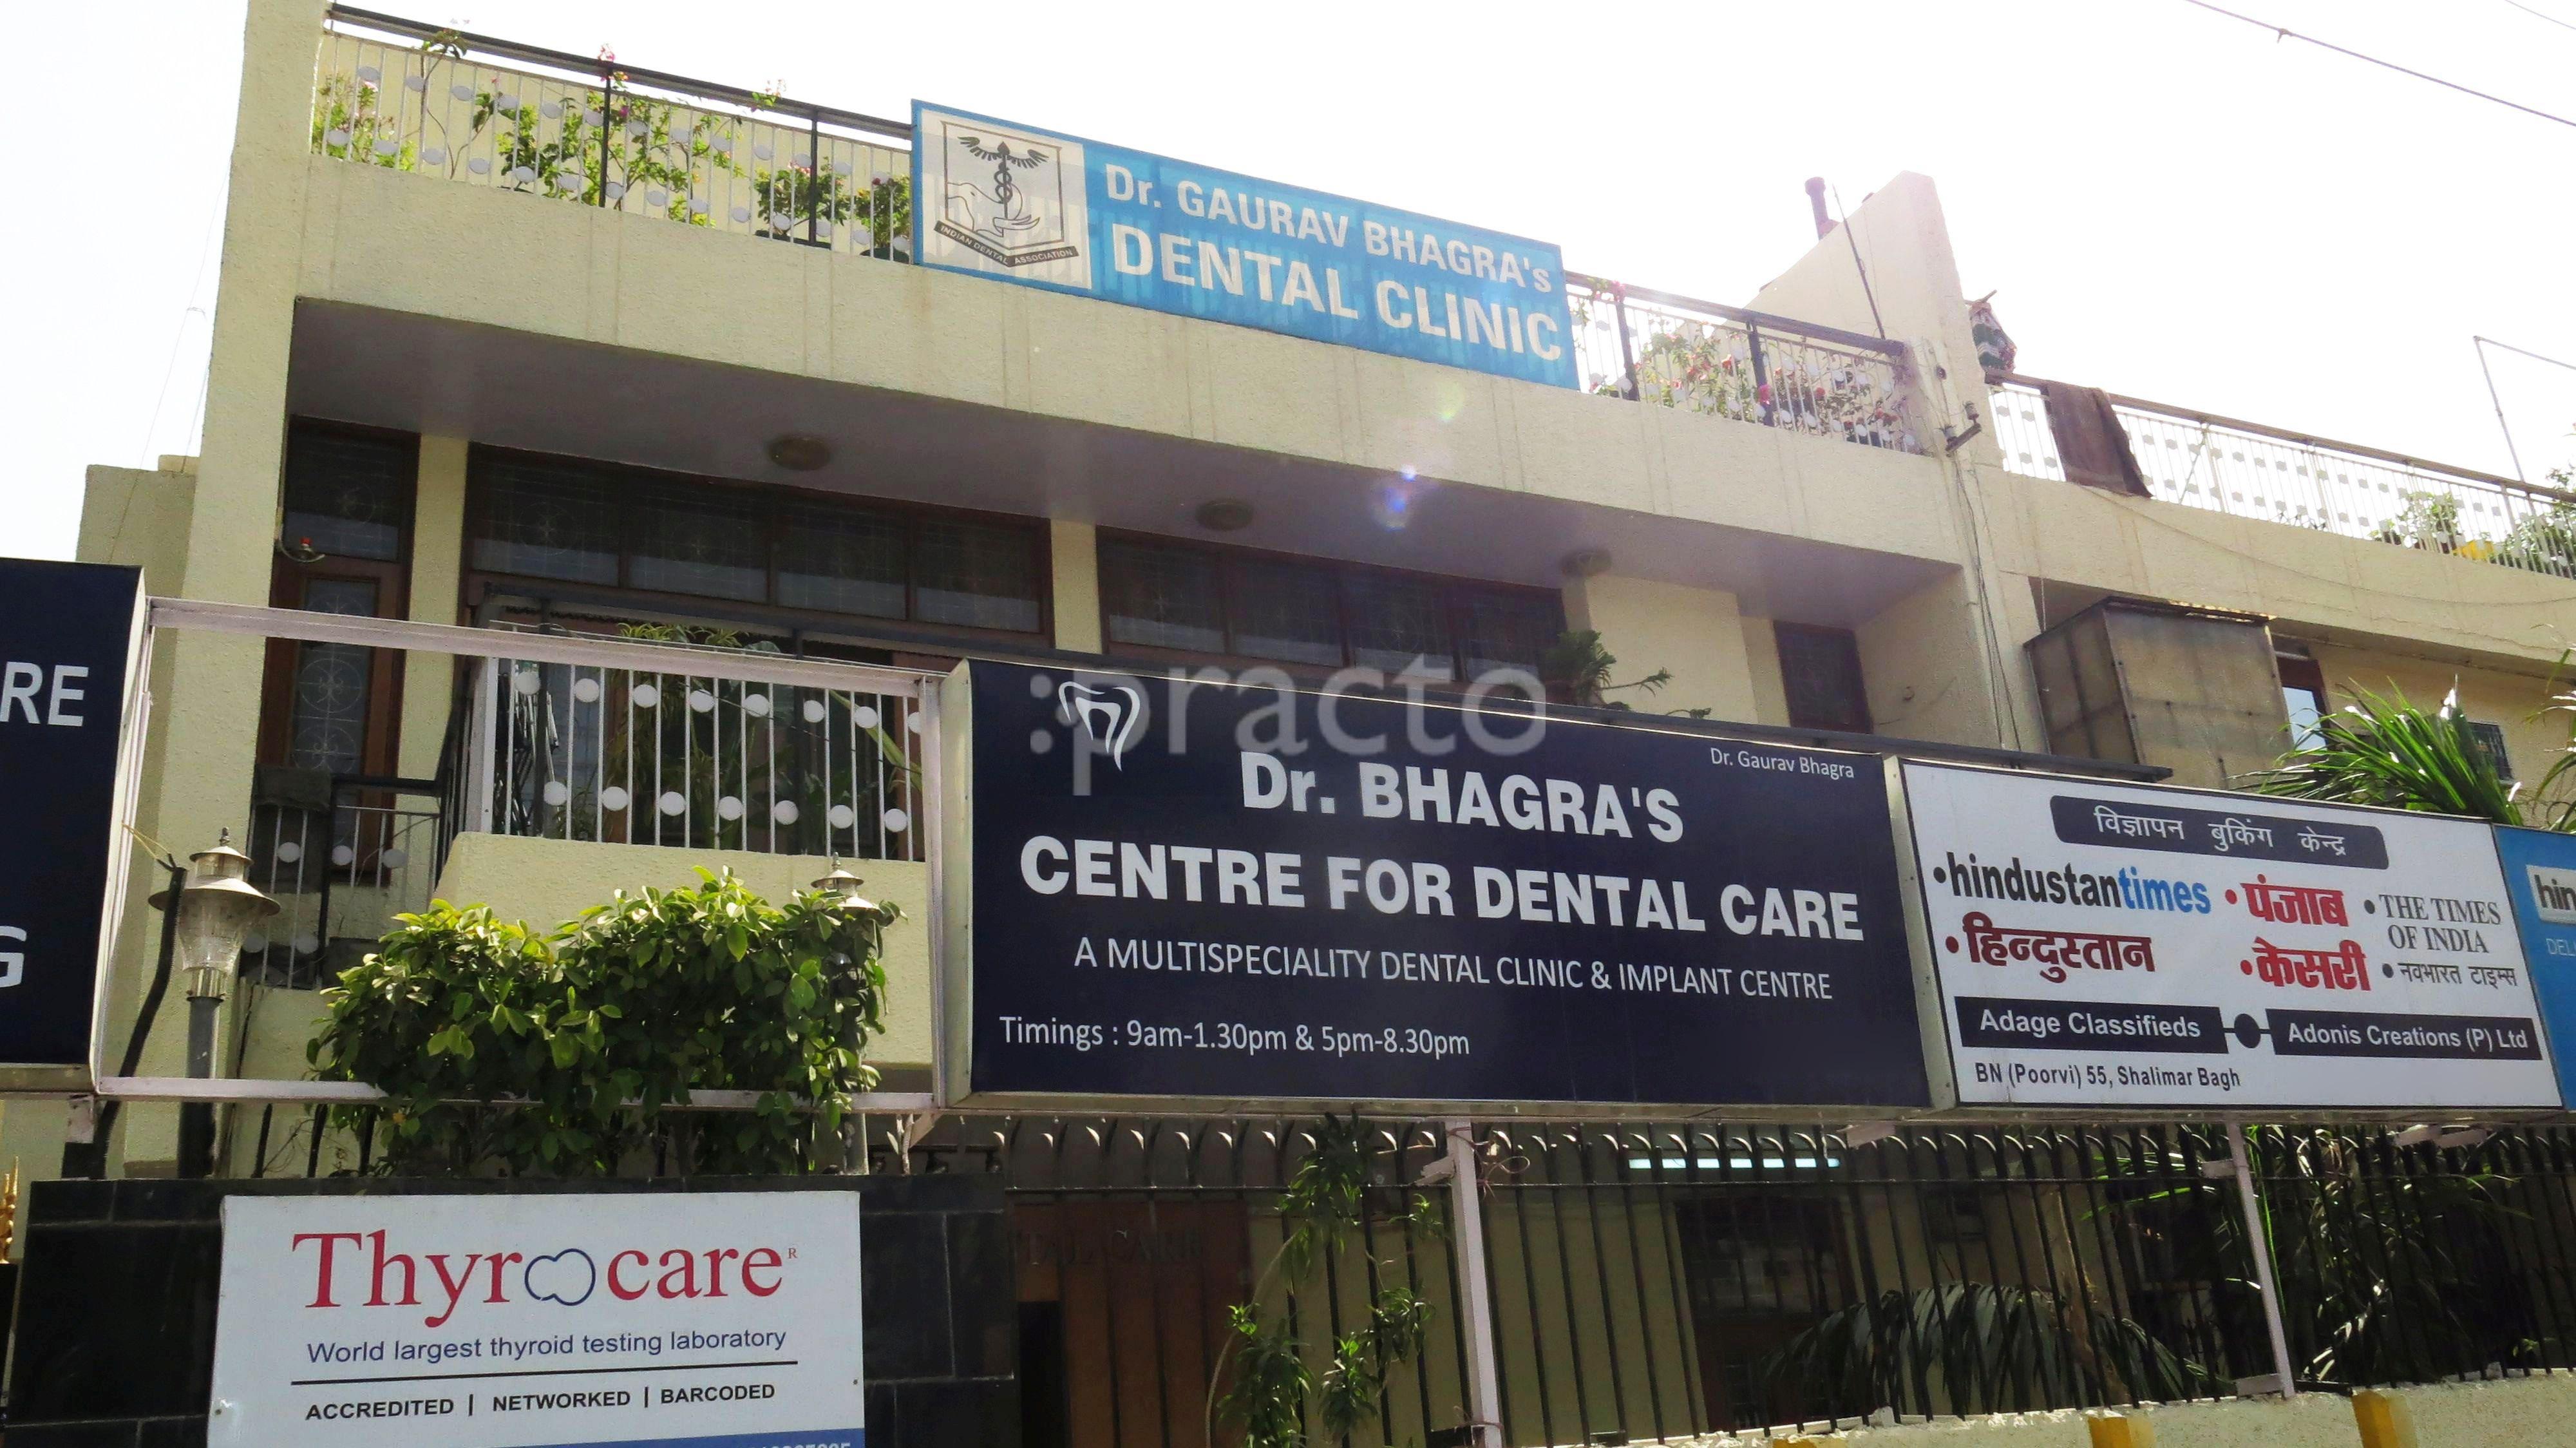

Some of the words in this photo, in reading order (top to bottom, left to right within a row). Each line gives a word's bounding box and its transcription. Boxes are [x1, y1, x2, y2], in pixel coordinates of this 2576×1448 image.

[940, 225, 971, 245] INDIAN
[974, 242, 1008, 265] DENTAL
[1014, 250, 1073, 265] ASSOCIATION
[1105, 164, 1162, 208] Dr.
[1177, 180, 1349, 248] GAURAV
[1363, 220, 1551, 293] BHAGRA's
[1112, 224, 1359, 319] DENTAL
[1375, 280, 1562, 361] CLINIC
[1710, 747, 1734, 767] Dr.
[1738, 750, 1795, 774] Gaurav
[1799, 757, 1855, 780] Bhagra
[1240, 752, 1338, 815] Dr.
[1360, 763, 1685, 844] BHAGRA'S
[2094, 805, 2184, 841] विज्ञापन
[2208, 818, 2273, 851] बुकिंग
[1020, 835, 1305, 908] CENTRE
[1328, 856, 1455, 917] FOR
[1475, 866, 1707, 932] DENTAL
[1719, 884, 1864, 941] CARE
[2240, 874, 2350, 926] पंजाब
[2379, 894, 2428, 920] THE
[2430, 899, 2502, 925] TIMES
[1962, 911, 2155, 984] हिन्दुस्तान
[2387, 926, 2416, 949] OF
[2418, 928, 2489, 954] INDIA
[2546, 938, 2576, 957] DEL
[1074, 938, 1098, 967] A
[1108, 939, 1372, 979] MULTISPECIALITY
[1380, 952, 1490, 984] DENTAL
[1497, 957, 1583, 989] CLINIC
[1592, 962, 1613, 990] &
[1620, 964, 1732, 996] IMPLANT
[1739, 969, 1833, 1000] CENTRE
[2251, 936, 2371, 991] केसरी
[2398, 962, 2462, 985] नवभारत
[2470, 960, 2517, 988] टाइम्स
[999, 1016, 1104, 1053] Timings
[1126, 1020, 1288, 1054] 9am-1.30pm
[1294, 1026, 1314, 1051] &
[1321, 1026, 1471, 1058] 5pm-8.30pm
[1978, 1009, 2063, 1036] Adage
[2068, 1013, 2201, 1039] Classifieds
[2287, 1023, 2363, 1045] Adonis
[2366, 1025, 2461, 1049] Creations
[2465, 1027, 2494, 1053] (P)
[2498, 1027, 2528, 1049] Ltd
[1975, 1063, 2003, 1083] BN
[2007, 1064, 2083, 1087] (Poorvi)
[2087, 1065, 2114, 1089] 55,
[2117, 1065, 2192, 1087] Shalimar
[2198, 1067, 2241, 1090] Bagh
[307, 1340, 385, 1363] World
[393, 1338, 482, 1364] largest
[489, 1334, 576, 1361] thyroid
[582, 1331, 662, 1355] testing
[669, 1328, 787, 1351] laboratory
[305, 1398, 455, 1420] ACCREDITED
[492, 1390, 631, 1413] NETWORKED
[659, 1384, 776, 1404] BARCODED
